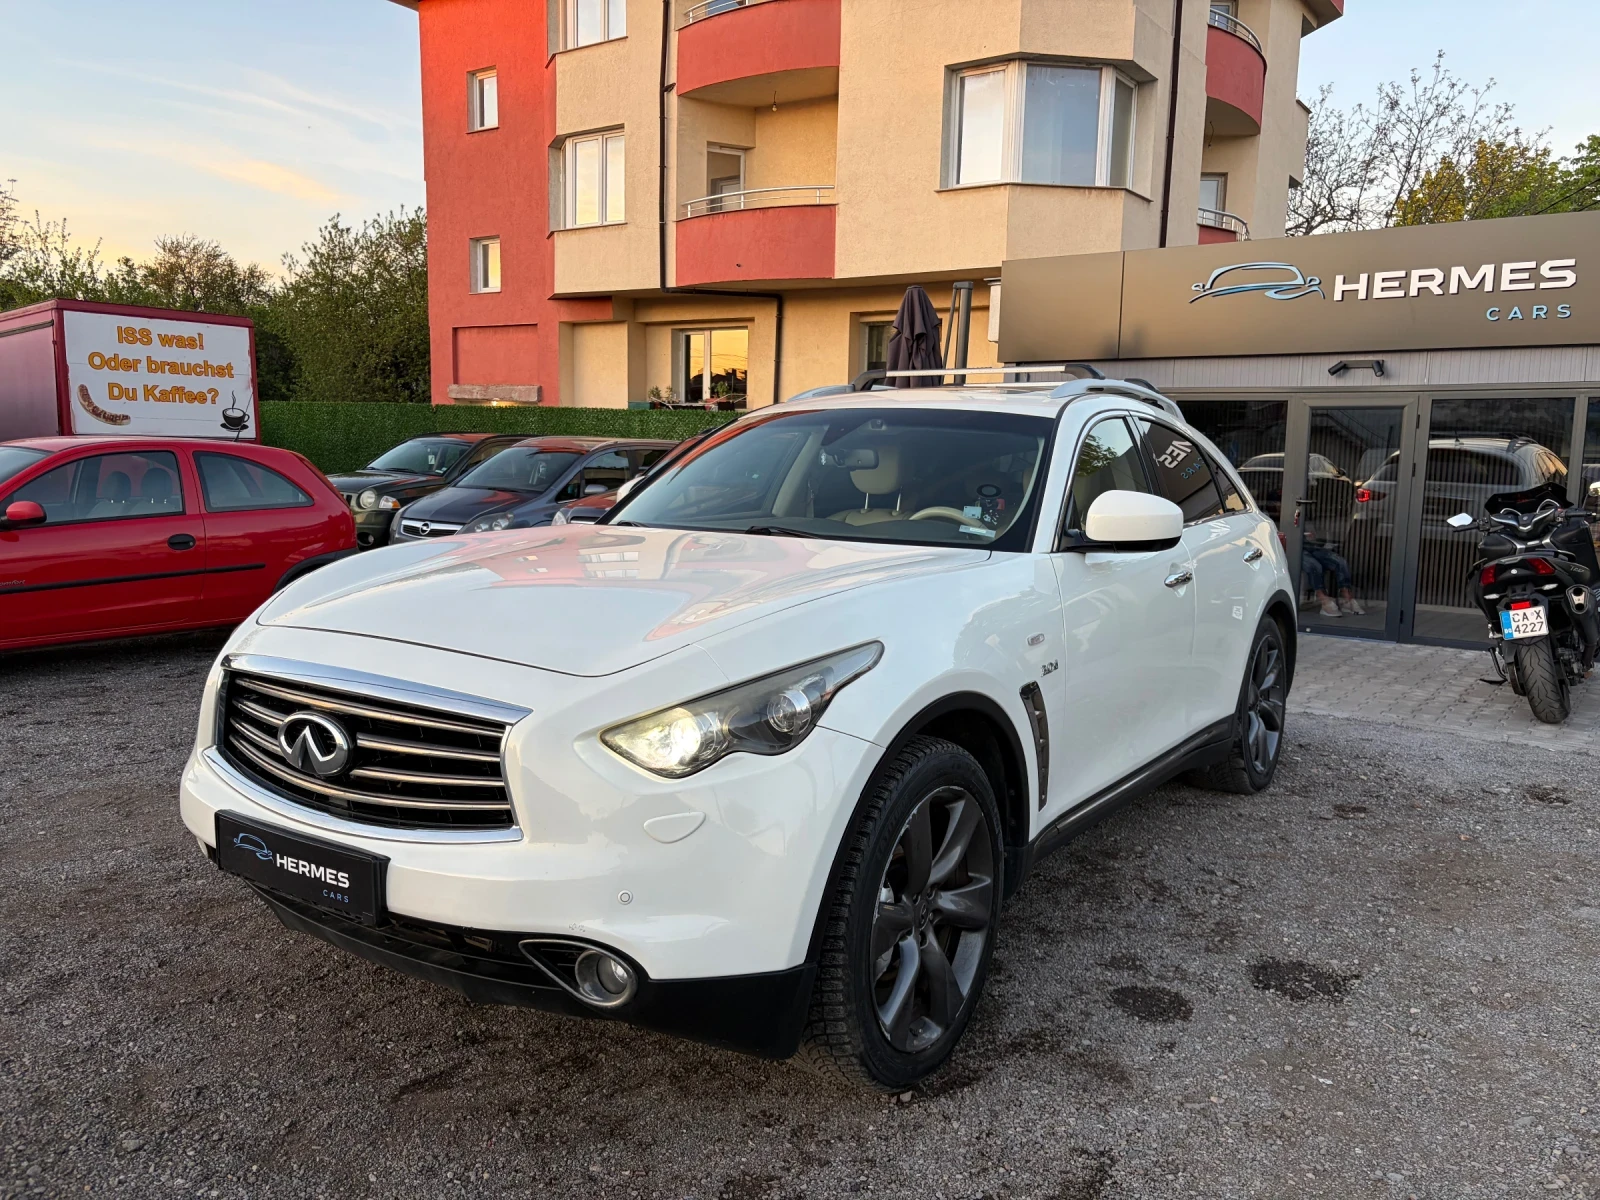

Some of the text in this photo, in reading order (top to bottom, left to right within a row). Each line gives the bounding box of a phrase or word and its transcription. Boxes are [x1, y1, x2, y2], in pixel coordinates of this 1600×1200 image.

[1333, 258, 1577, 302] HERMES
[1486, 303, 1572, 321] CARS
[117, 326, 204, 350] ISS was!
[88, 352, 234, 378] Oder brauchst
[108, 382, 219, 404] Du Kaffee?
[1512, 610, 1542, 623] CA X
[1514, 621, 1543, 634] 4227
[276, 853, 350, 889] HERMES
[323, 889, 349, 903] CARS
